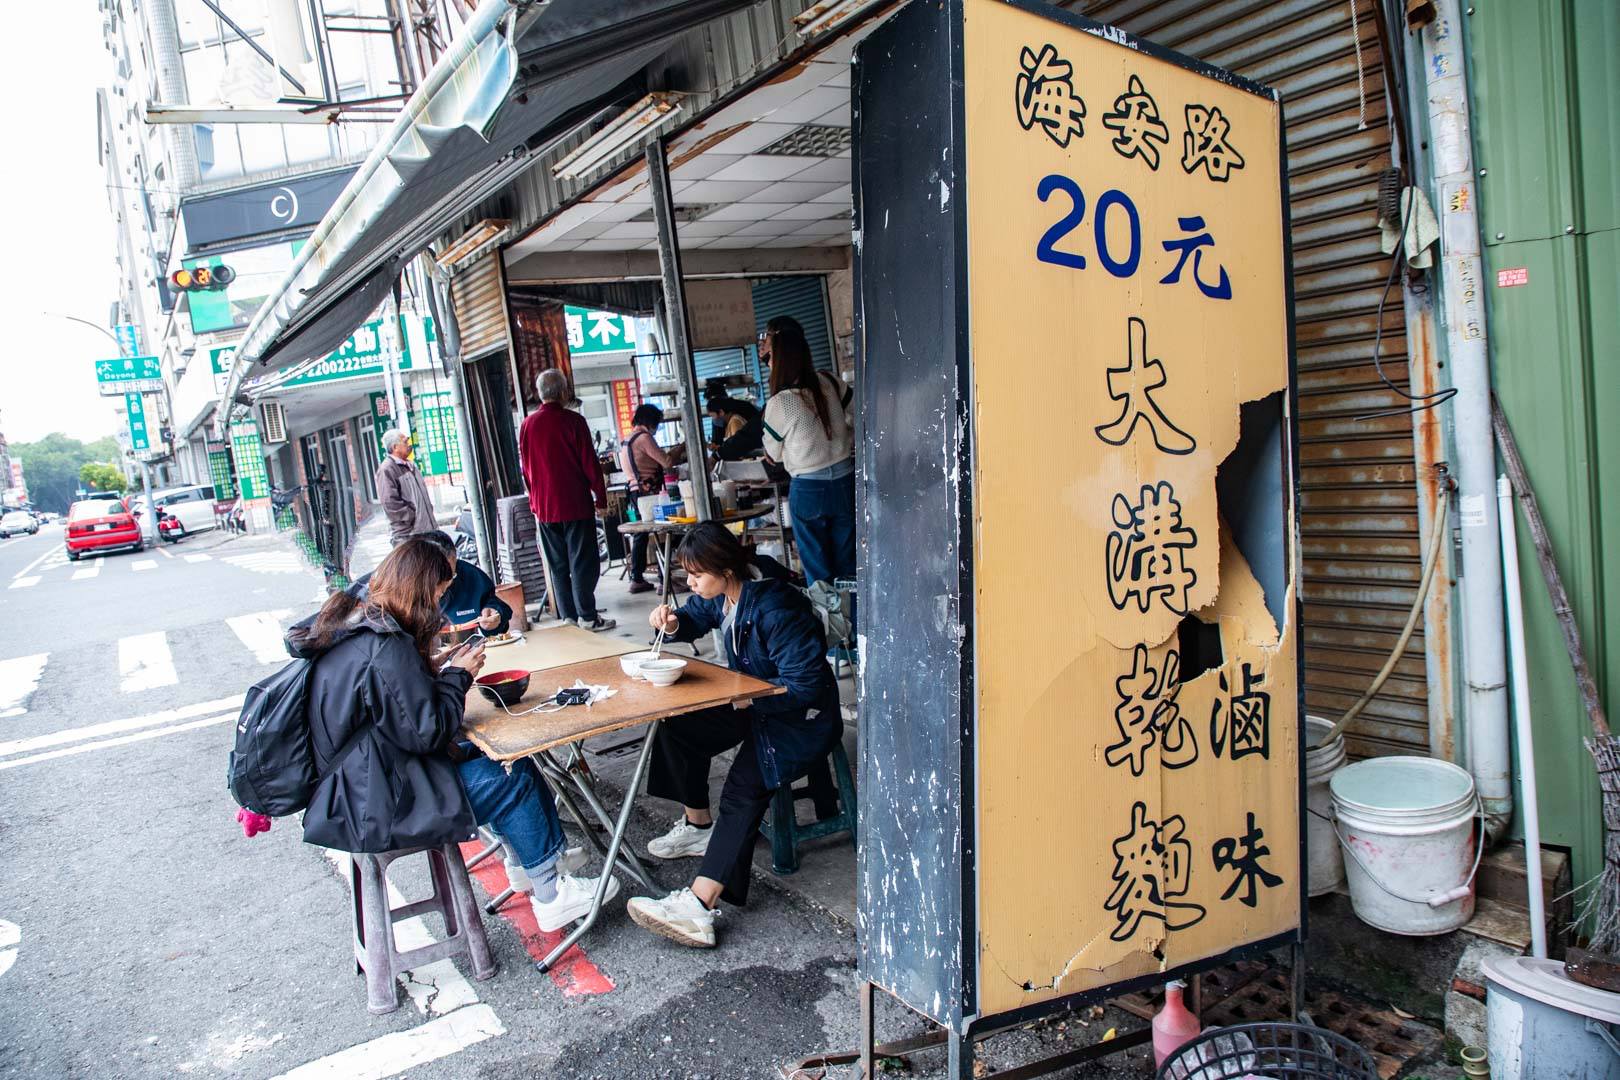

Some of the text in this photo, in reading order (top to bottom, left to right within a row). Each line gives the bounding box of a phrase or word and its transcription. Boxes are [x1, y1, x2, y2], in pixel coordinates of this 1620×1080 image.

[1015, 44, 1245, 182] 海安路
[1037, 174, 1233, 300] 20元
[1211, 663, 1284, 908] 滷味
